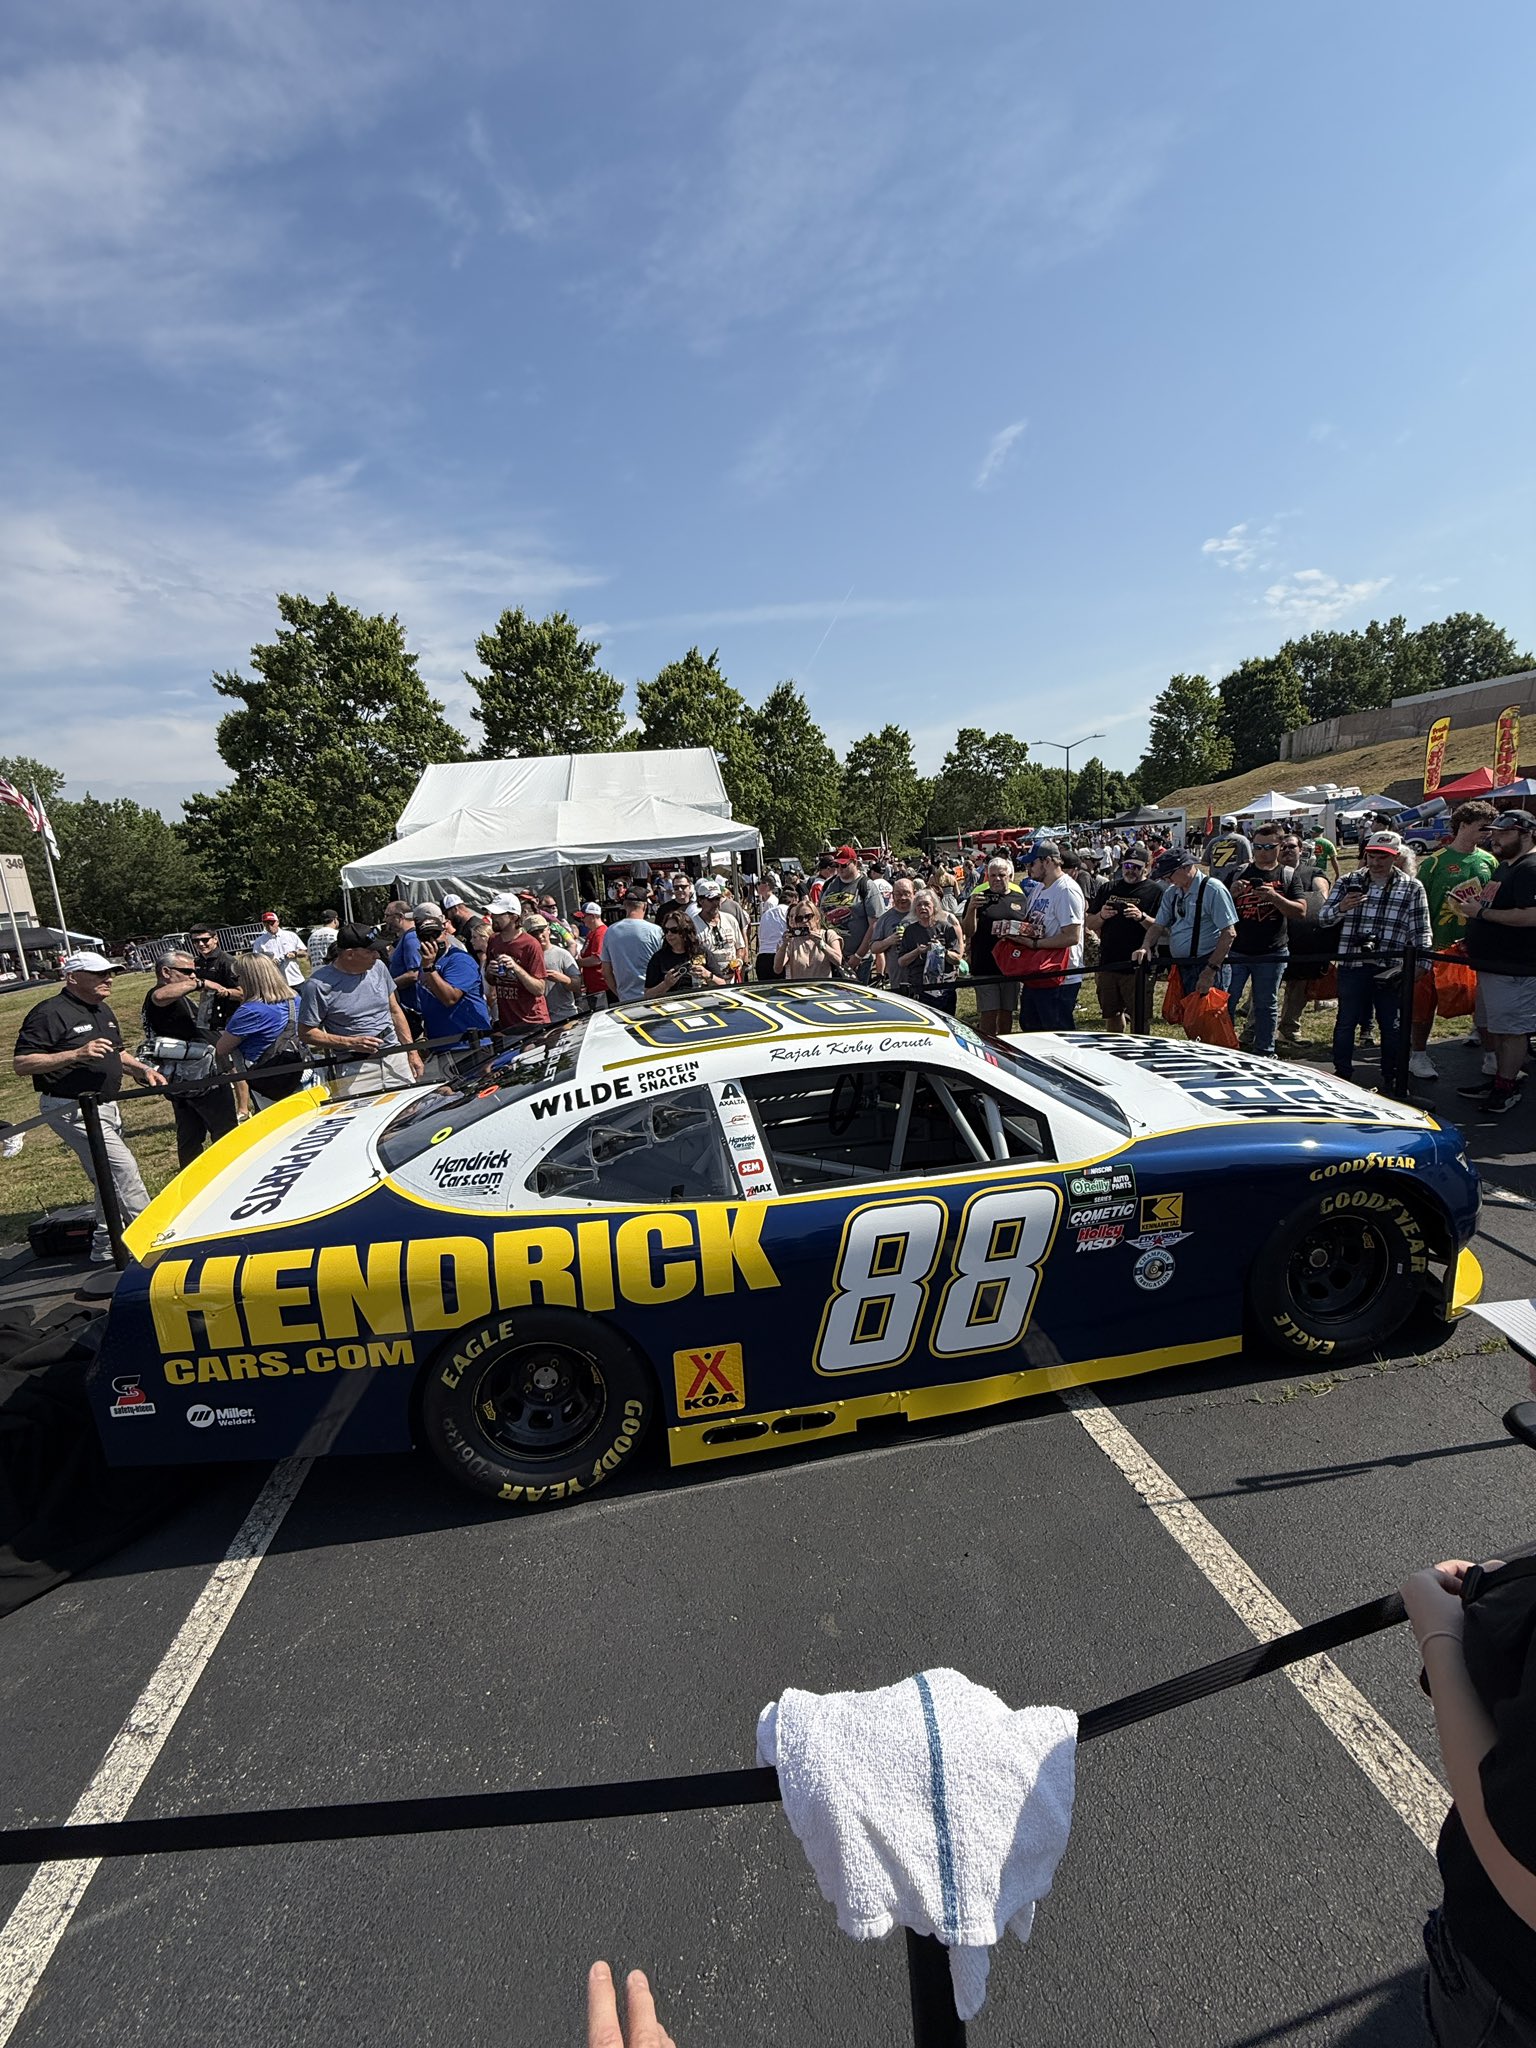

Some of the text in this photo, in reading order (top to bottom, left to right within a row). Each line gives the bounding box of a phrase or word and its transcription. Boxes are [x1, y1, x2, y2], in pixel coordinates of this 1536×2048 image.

[5, 858, 24, 870] 349
[1214, 847, 1237, 868] 7
[769, 1036, 934, 1063] Rajah Kirby Caruth
[637, 1060, 700, 1082] PROTEIN
[639, 1071, 698, 1093] SNACKS
[530, 1077, 633, 1121] WILDE
[719, 1099, 745, 1107] AXALTA
[290, 1116, 357, 1152] AUTO
[729, 1134, 756, 1147] Hendrick
[429, 1149, 512, 1180] Hendrick
[741, 1161, 761, 1174] SEM
[1090, 1165, 1113, 1175] NASCAR
[230, 1149, 323, 1221] PARTS
[438, 1172, 504, 1188] Cars.com
[1073, 1178, 1110, 1194] O'Reilly
[1111, 1181, 1132, 1191] PARTS
[1112, 1174, 1130, 1184] AUTO
[1093, 1195, 1113, 1204] SERIES
[1070, 1203, 1135, 1224] COMETIC
[1080, 1224, 1124, 1240] Holley
[1141, 1220, 1180, 1230] KENNAMETAL
[1075, 1237, 1117, 1253] MSD
[1138, 1250, 1171, 1266] CHAMPION
[150, 1206, 782, 1354] HENDRICK
[812, 1181, 1064, 1377] 88
[1272, 1312, 1336, 1356] EAGLE
[440, 1319, 514, 1390] EAGLE
[163, 1340, 415, 1386] CARS.COM
[684, 1391, 735, 1411] KOA
[216, 1408, 254, 1419] Miller
[217, 1418, 256, 1427] Welders
